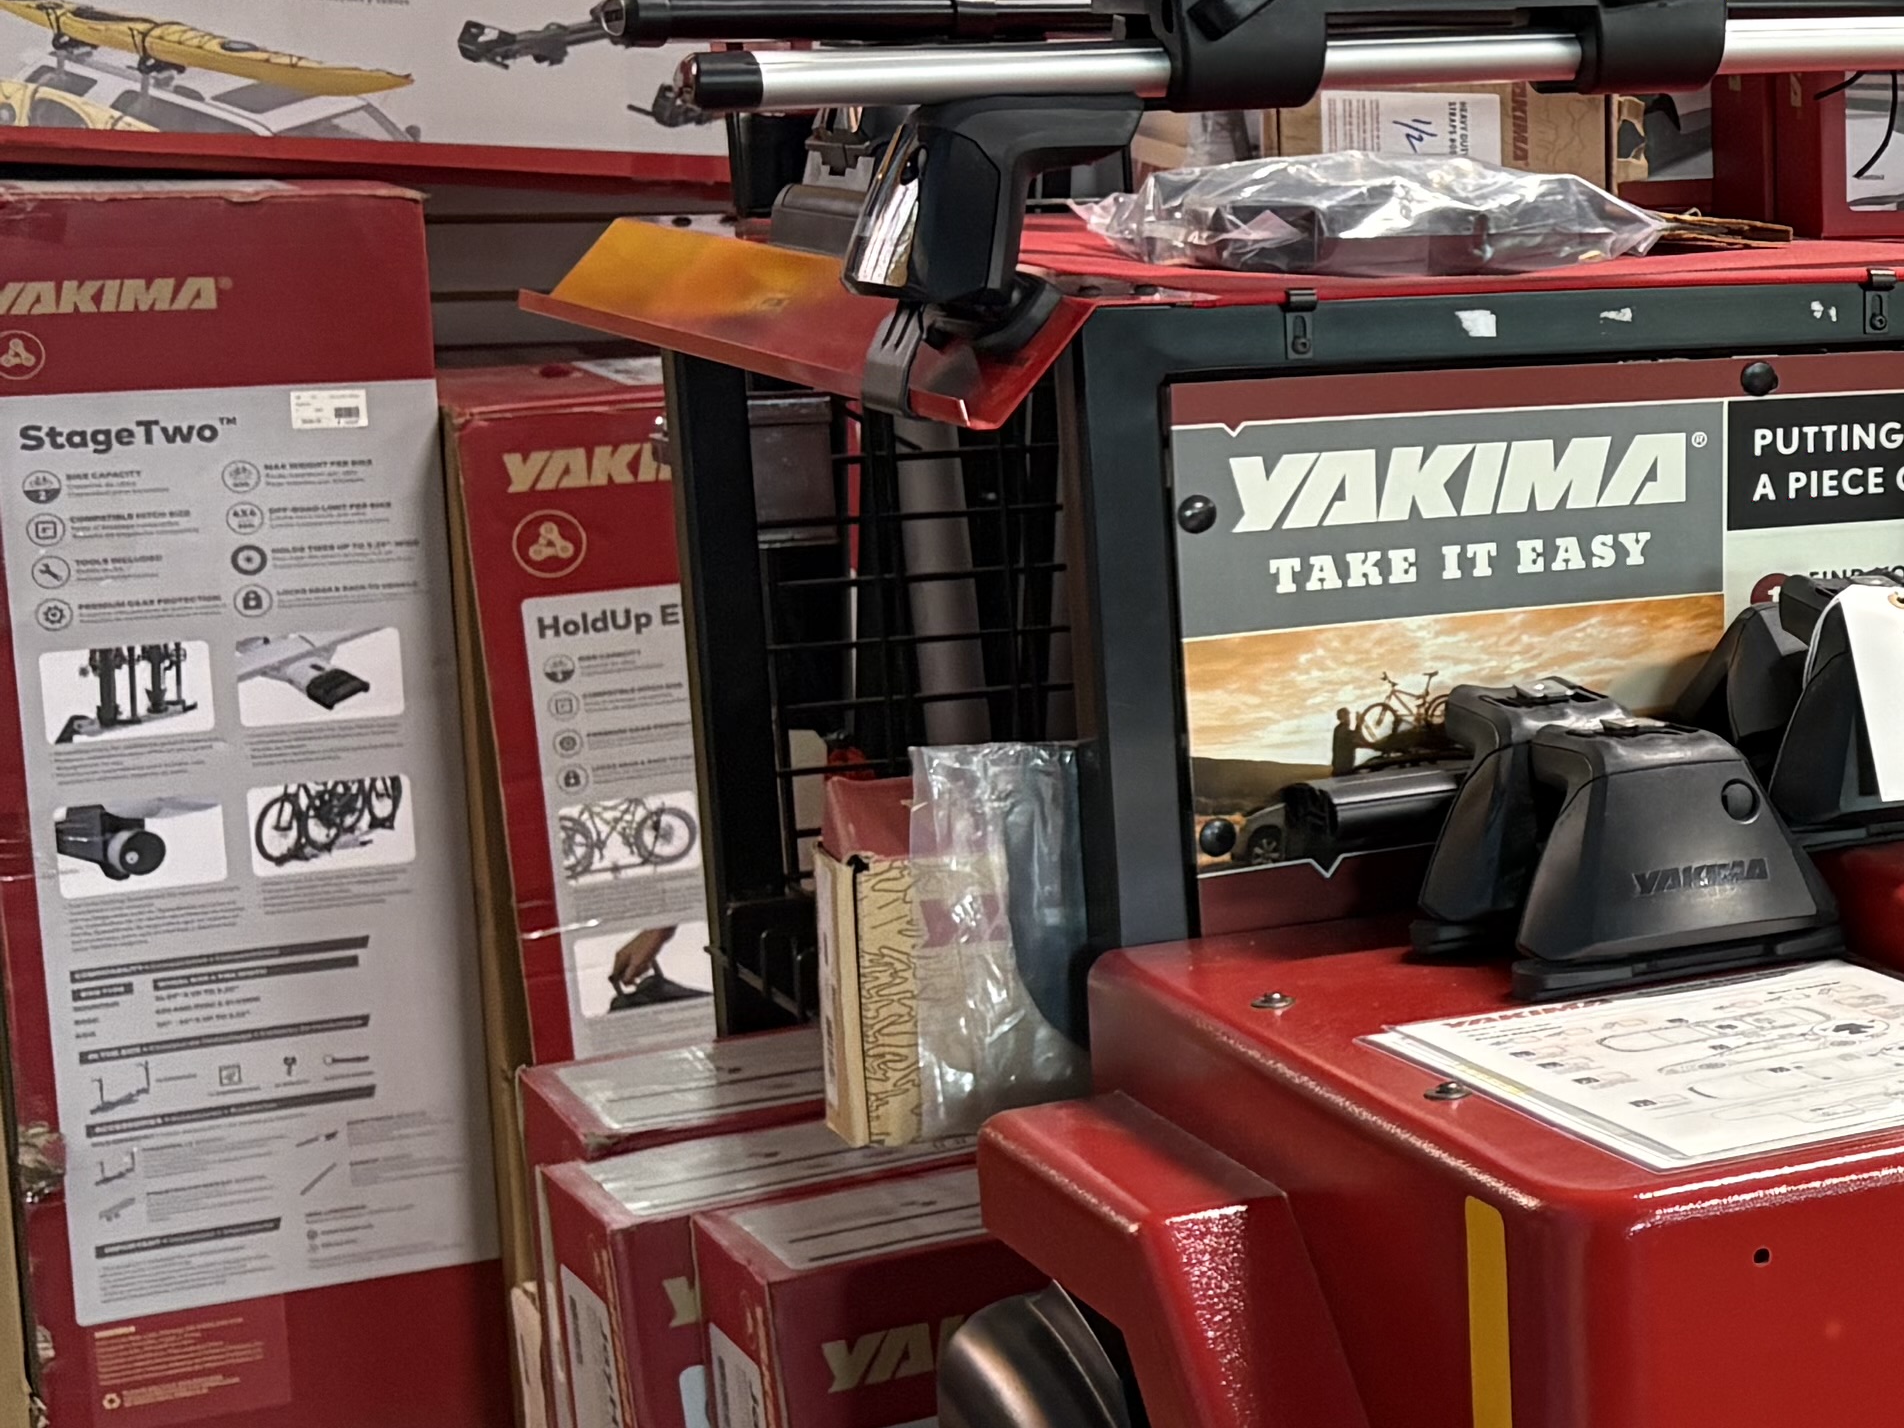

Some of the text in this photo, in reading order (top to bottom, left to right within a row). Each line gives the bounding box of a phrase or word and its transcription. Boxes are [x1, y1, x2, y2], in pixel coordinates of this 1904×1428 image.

[1754, 421, 1904, 459] PUTTING
[1754, 474, 1775, 503] A
[1788, 468, 1885, 498] PIECE
[1269, 532, 1652, 595] TAKE IT EASY
[537, 606, 654, 640] HoldUp
